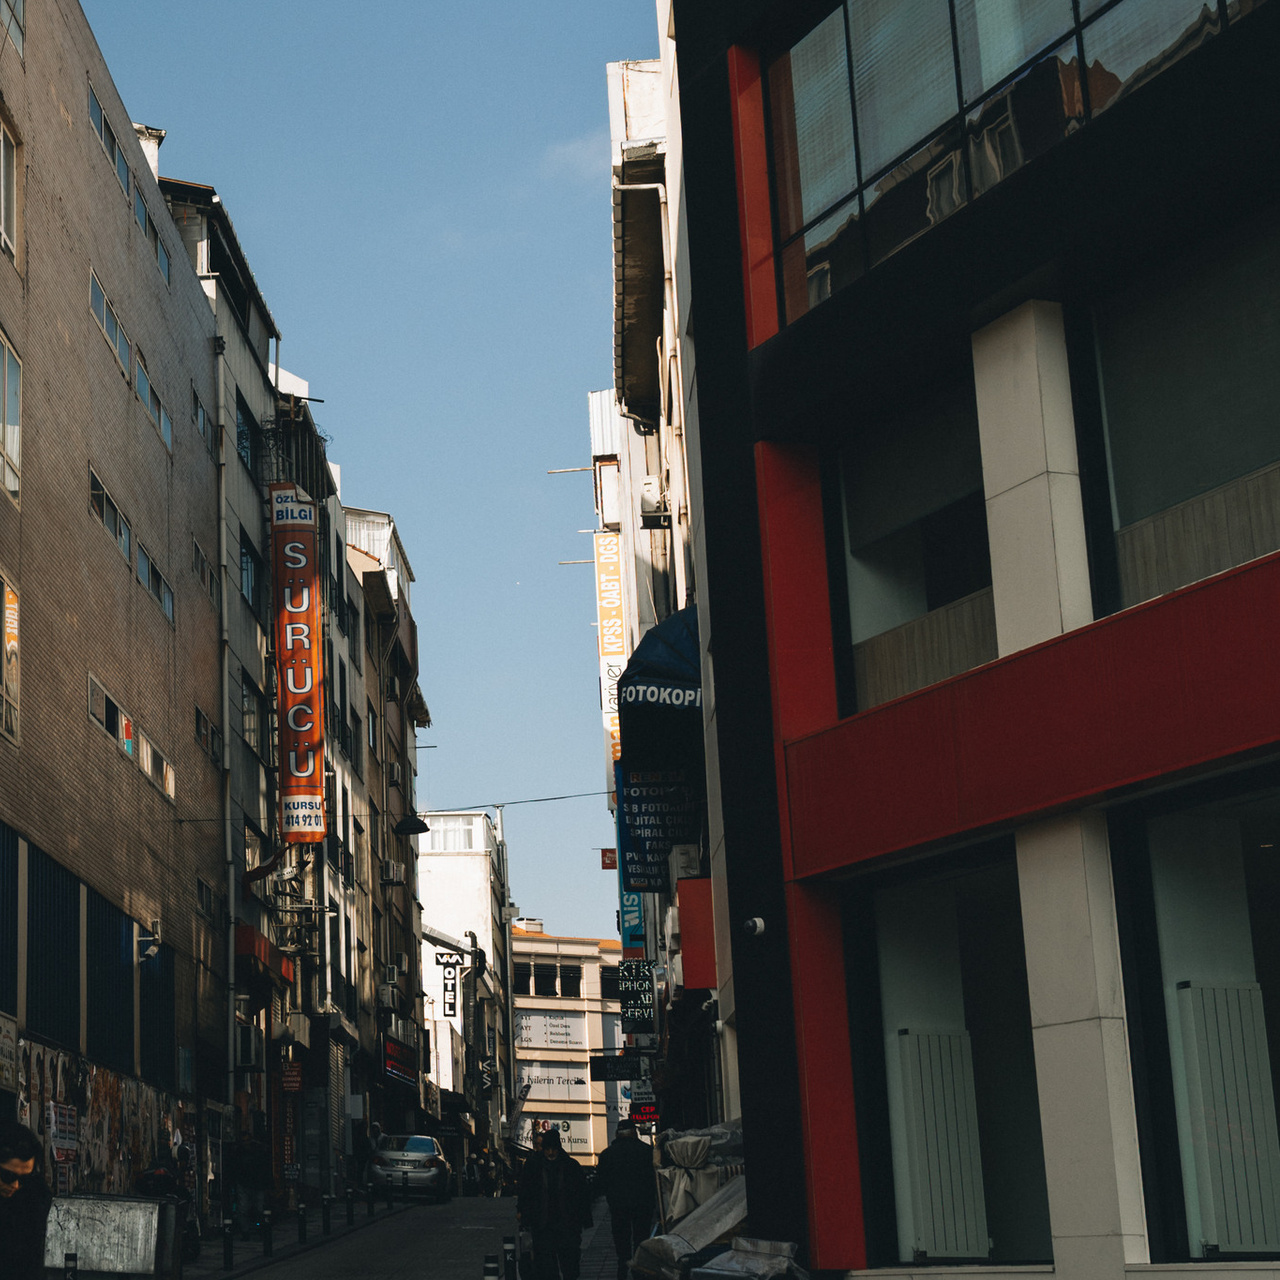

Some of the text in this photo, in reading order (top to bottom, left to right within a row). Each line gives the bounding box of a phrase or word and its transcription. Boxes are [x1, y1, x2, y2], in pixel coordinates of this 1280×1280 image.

[276, 507, 312, 520] BİLGİ
[599, 536, 618, 563] DGS
[602, 619, 623, 653] KPSS
[282, 541, 316, 779] SÜRÜCÜ
[621, 685, 701, 707] FOTOKOPİ
[284, 802, 321, 811] KURSU
[285, 814, 322, 826] 414 92 01
[646, 841, 671, 850] FAKS
[444, 967, 455, 1015] OTEL
[568, 1135, 588, 1143] Kursu
